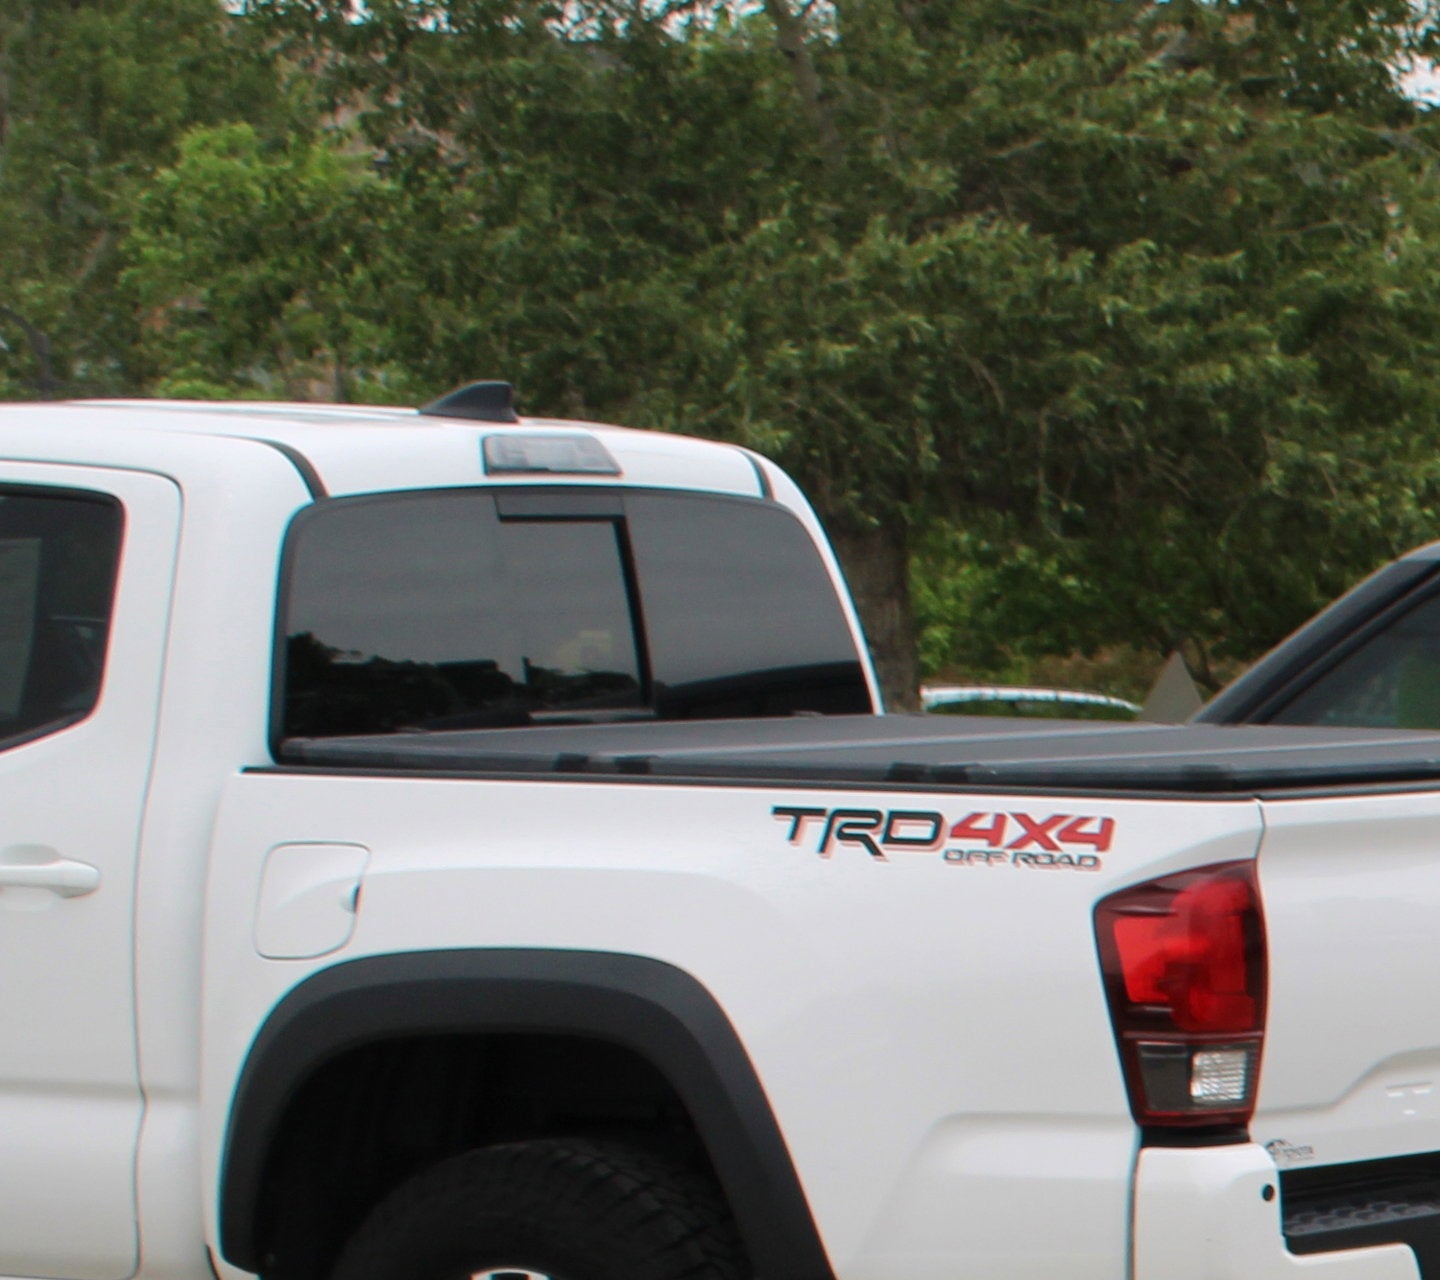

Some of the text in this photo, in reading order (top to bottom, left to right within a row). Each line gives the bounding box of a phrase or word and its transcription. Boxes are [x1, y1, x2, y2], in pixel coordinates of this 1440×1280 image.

[771, 806, 948, 860] TRD
[943, 848, 1102, 871] OFF ROAD
